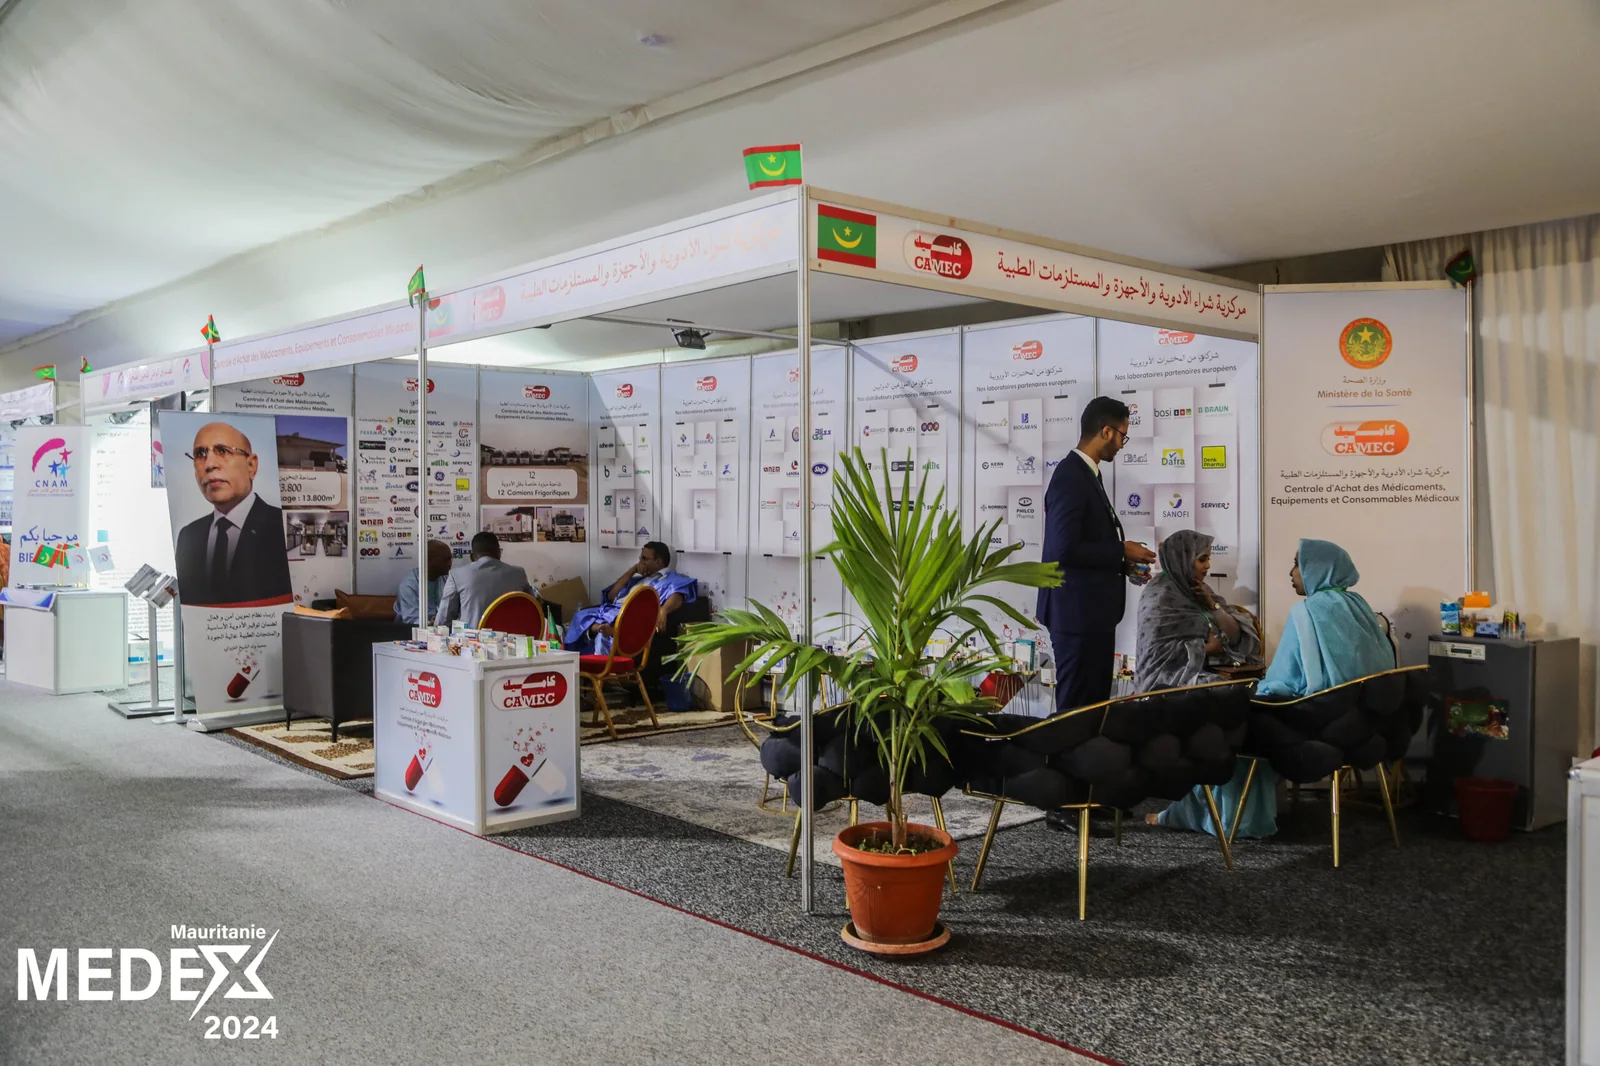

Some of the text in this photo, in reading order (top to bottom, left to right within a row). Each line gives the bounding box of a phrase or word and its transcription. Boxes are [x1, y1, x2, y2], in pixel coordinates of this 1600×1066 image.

[914, 256, 962, 276] CAMEC
[998, 252, 1246, 320] مركزية شراء الأدوية والأجهزة والمستلزمات الطبية
[1158, 336, 1188, 345] CAMEC
[1012, 352, 1037, 360] CAMEC
[1127, 371, 1164, 380] laboratoires
[1164, 368, 1200, 378] partenaires
[1202, 364, 1237, 374] européens
[987, 384, 1017, 392] laboratoires
[1018, 380, 1048, 390] partenaires
[1048, 378, 1077, 387] européens
[1343, 376, 1387, 386] وزارة الصحة
[892, 392, 918, 400] partenaires
[1317, 388, 1412, 398] Ministère de la Santé
[1154, 408, 1172, 418] basi
[1334, 441, 1396, 454] CAMEC
[1161, 456, 1186, 466] Dafra
[529, 471, 536, 479] 12
[1280, 466, 1450, 480] مركزية شراء الأدوية والأجهزة والمستلزمات الطبية
[35, 480, 68, 488] CNAM
[280, 483, 302, 492] 3.800
[1284, 482, 1446, 493] Centrale d'Achat des Médicaments,
[535, 489, 570, 498] Frigorifiques
[1271, 494, 1460, 506] Equipements et Consommables Médicaux
[20, 525, 78, 549] مرحبا بكم
[408, 689, 436, 706] CAMEC
[504, 692, 556, 708] CAMEC
